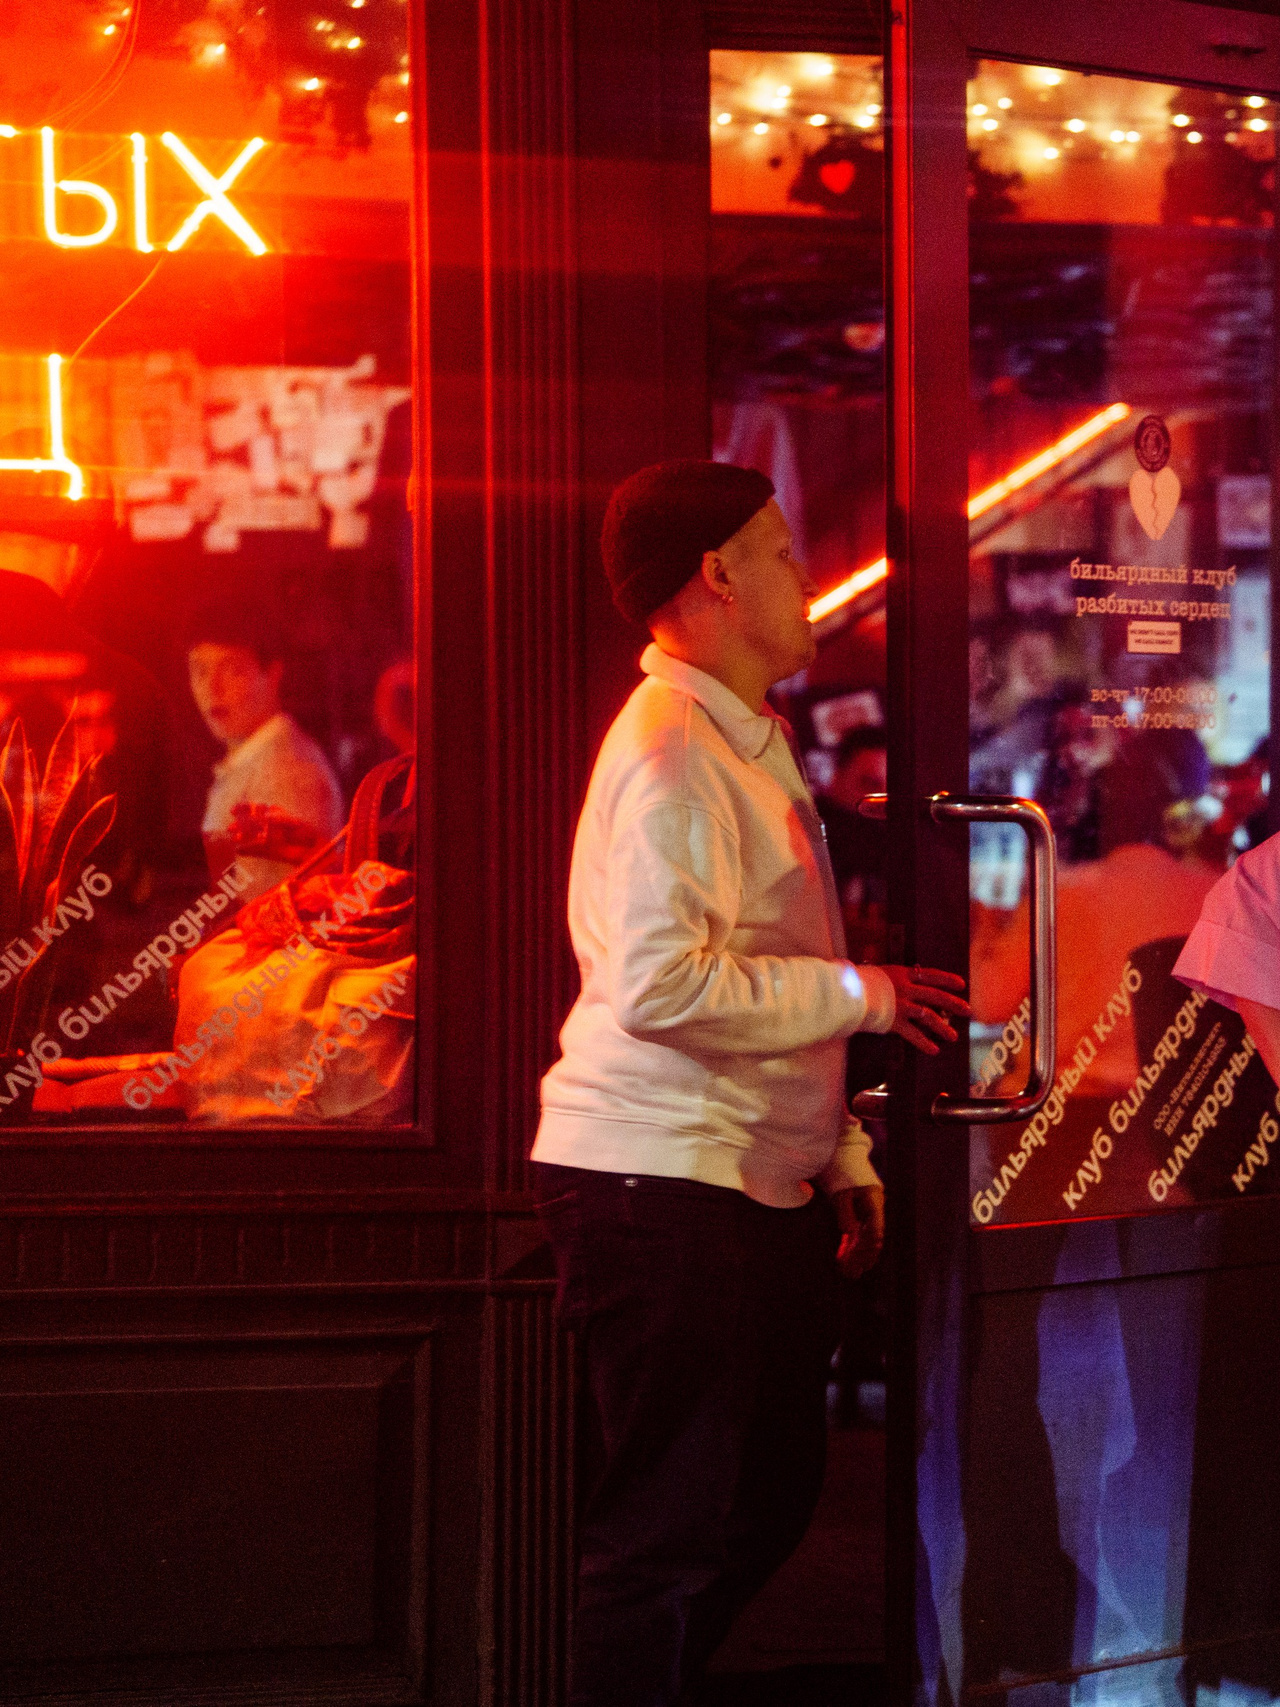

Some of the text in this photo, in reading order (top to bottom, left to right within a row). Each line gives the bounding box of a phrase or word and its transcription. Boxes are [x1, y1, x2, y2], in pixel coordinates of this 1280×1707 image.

[0, 124, 269, 257] ЫХ
[1069, 556, 1237, 591] бильярдный клуб
[1076, 592, 1232, 621] разбитых сердец
[32, 864, 113, 945] клуб
[0, 863, 254, 1113] луб бильярдный
[121, 861, 388, 1111] бильярдный клуб
[265, 1029, 341, 1107] клуб
[972, 961, 1143, 1224] бильярдный клуб
[1062, 1126, 1113, 1211] клуб
[1231, 1111, 1279, 1192] клуб
